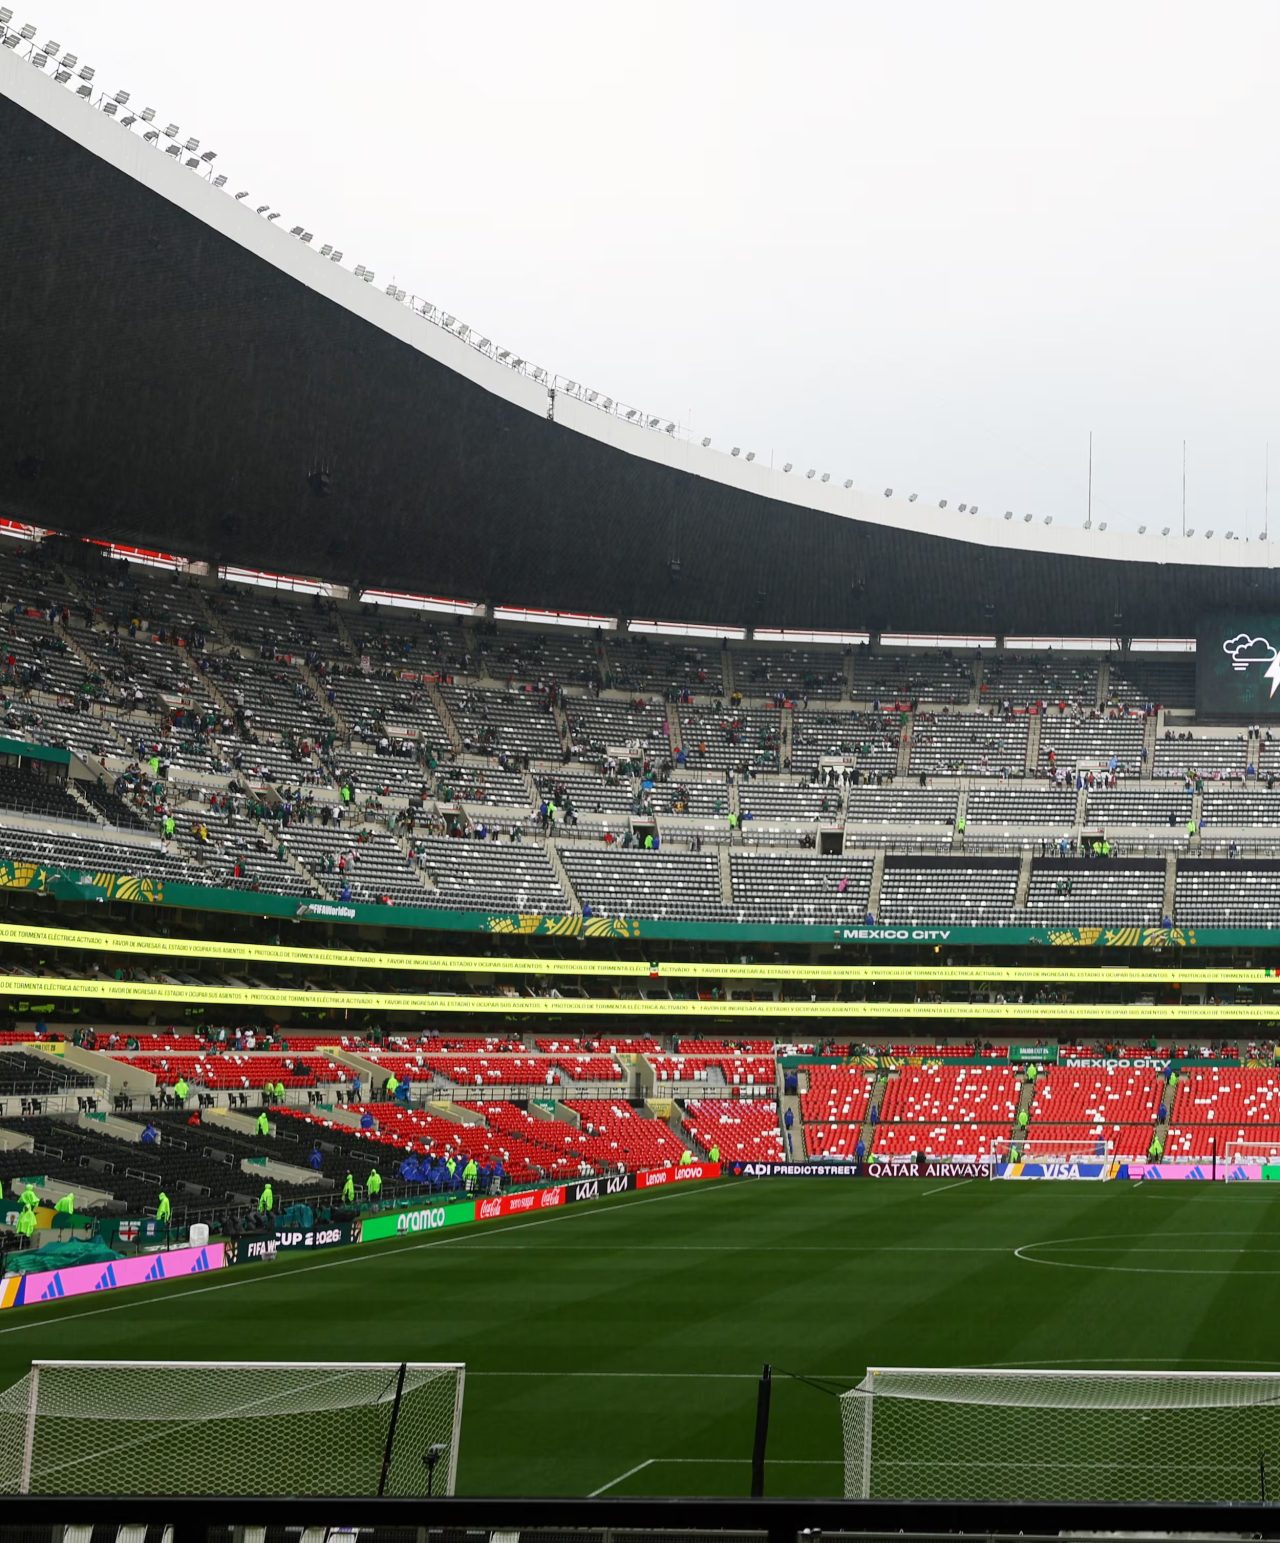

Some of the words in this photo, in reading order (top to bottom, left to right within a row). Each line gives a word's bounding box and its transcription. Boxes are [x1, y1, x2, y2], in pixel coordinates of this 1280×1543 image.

[309, 904, 356, 918] #FIFAWorldCup
[844, 930, 908, 939] MEXICO
[912, 930, 950, 940] CITY
[1066, 1059, 1130, 1068] MEXICO
[1134, 1059, 1171, 1068] CITY
[646, 1171, 666, 1186] Lenovo
[674, 1167, 702, 1180] Lenovo
[744, 1164, 770, 1175] ADI
[868, 1164, 919, 1178] QATAR
[926, 1164, 989, 1176] AIRWAYS
[1042, 1165, 1080, 1178] VISA
[575, 1181, 599, 1200] KIA
[607, 1176, 628, 1194] KIA
[397, 1208, 445, 1232] aramco
